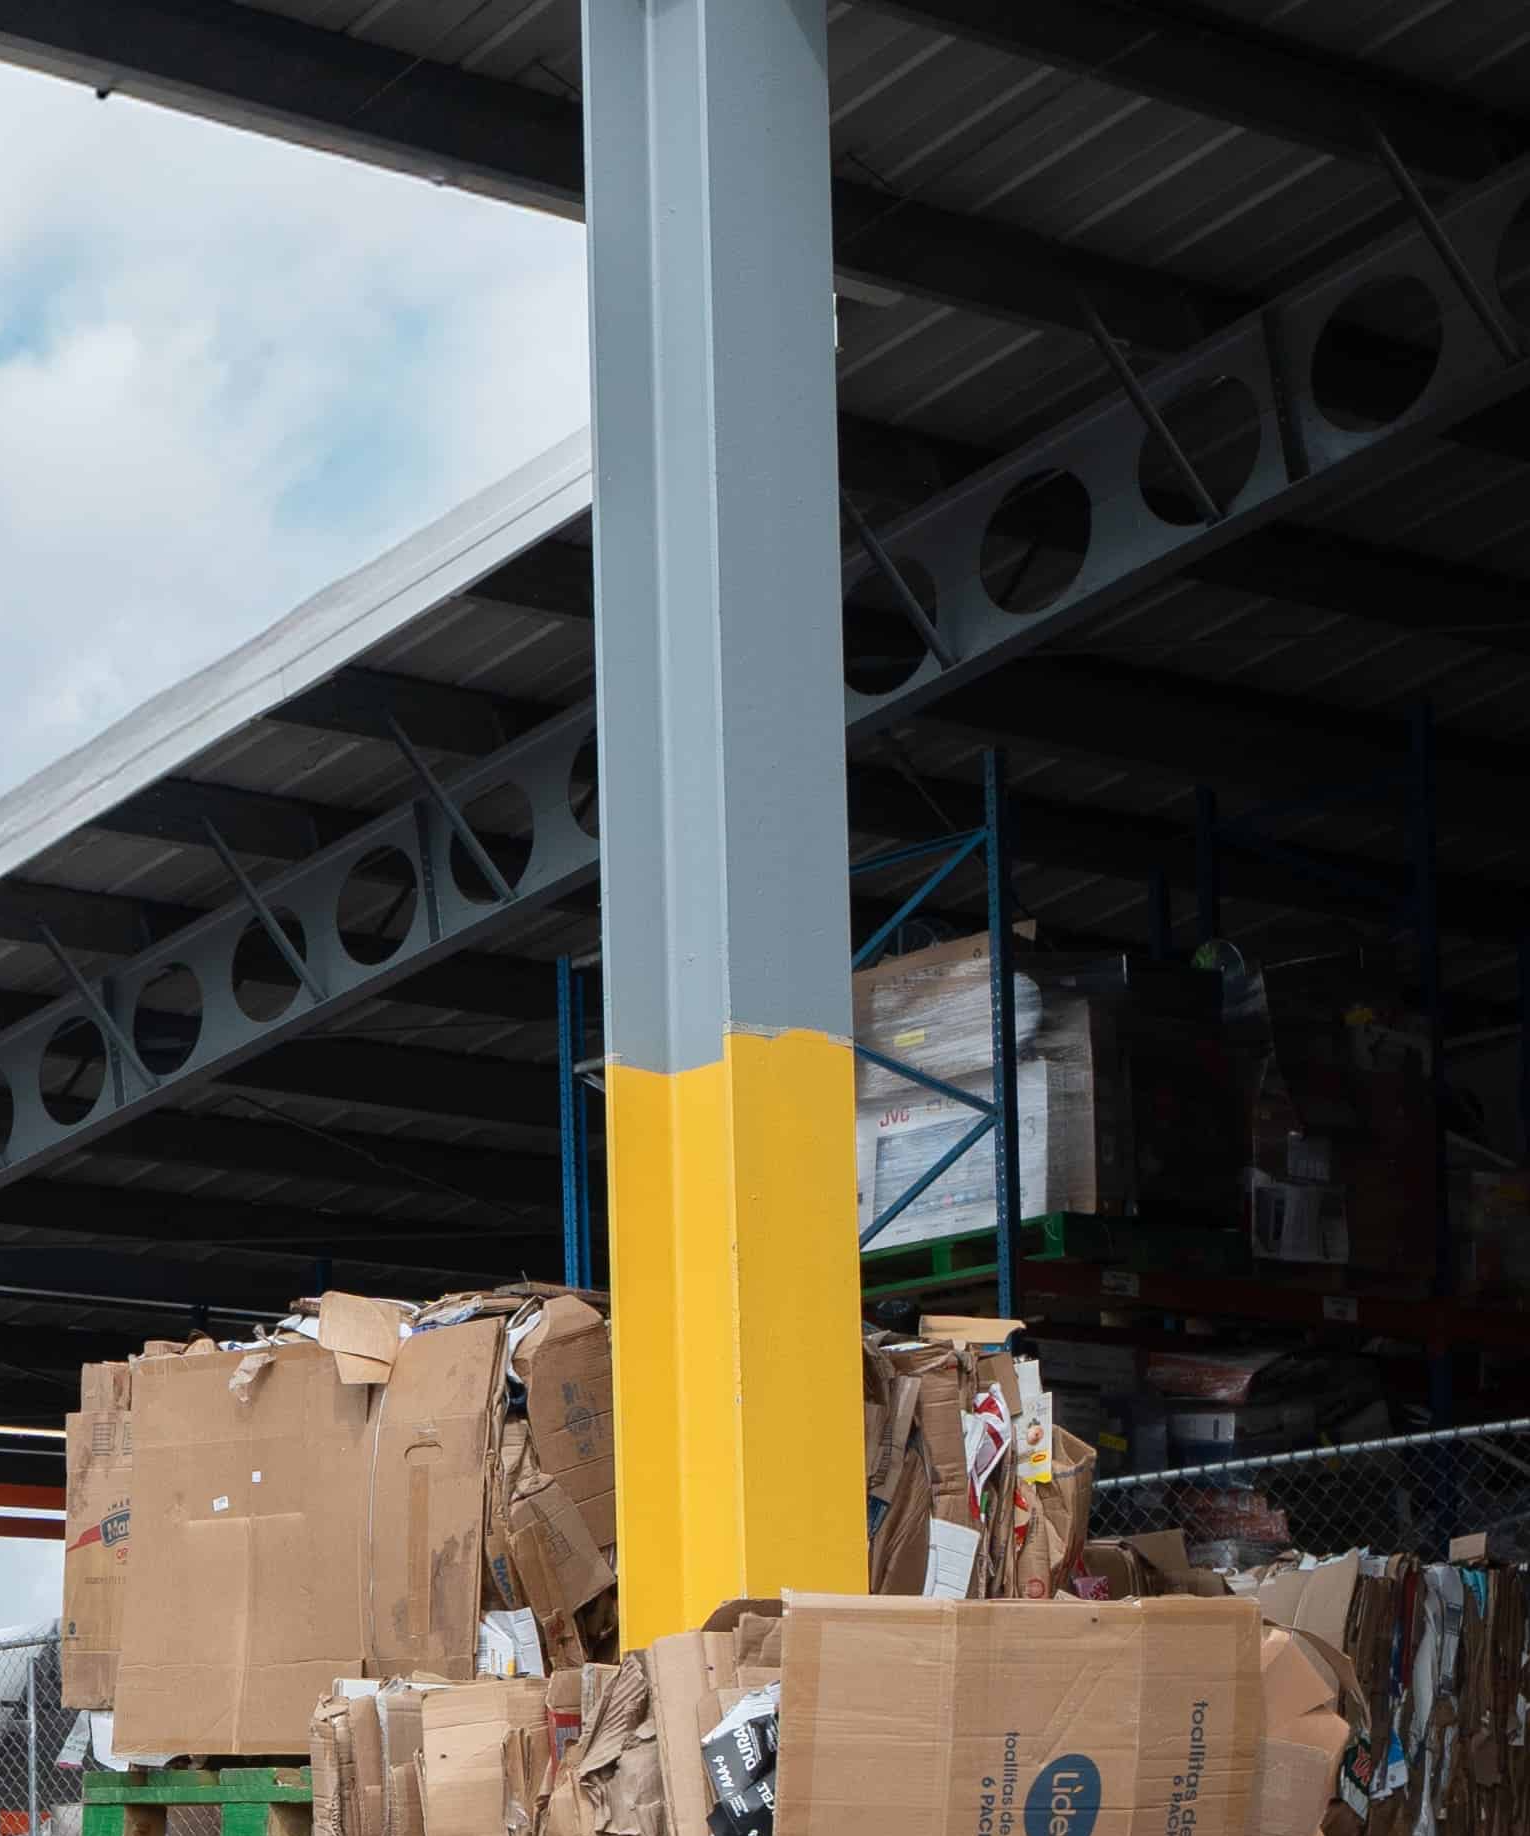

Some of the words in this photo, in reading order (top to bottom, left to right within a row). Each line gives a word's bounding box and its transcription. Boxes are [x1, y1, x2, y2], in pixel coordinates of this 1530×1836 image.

[981, 1777, 997, 1789] 6
[1172, 1775, 1184, 1787] 6
[999, 1810, 1014, 1836] de
